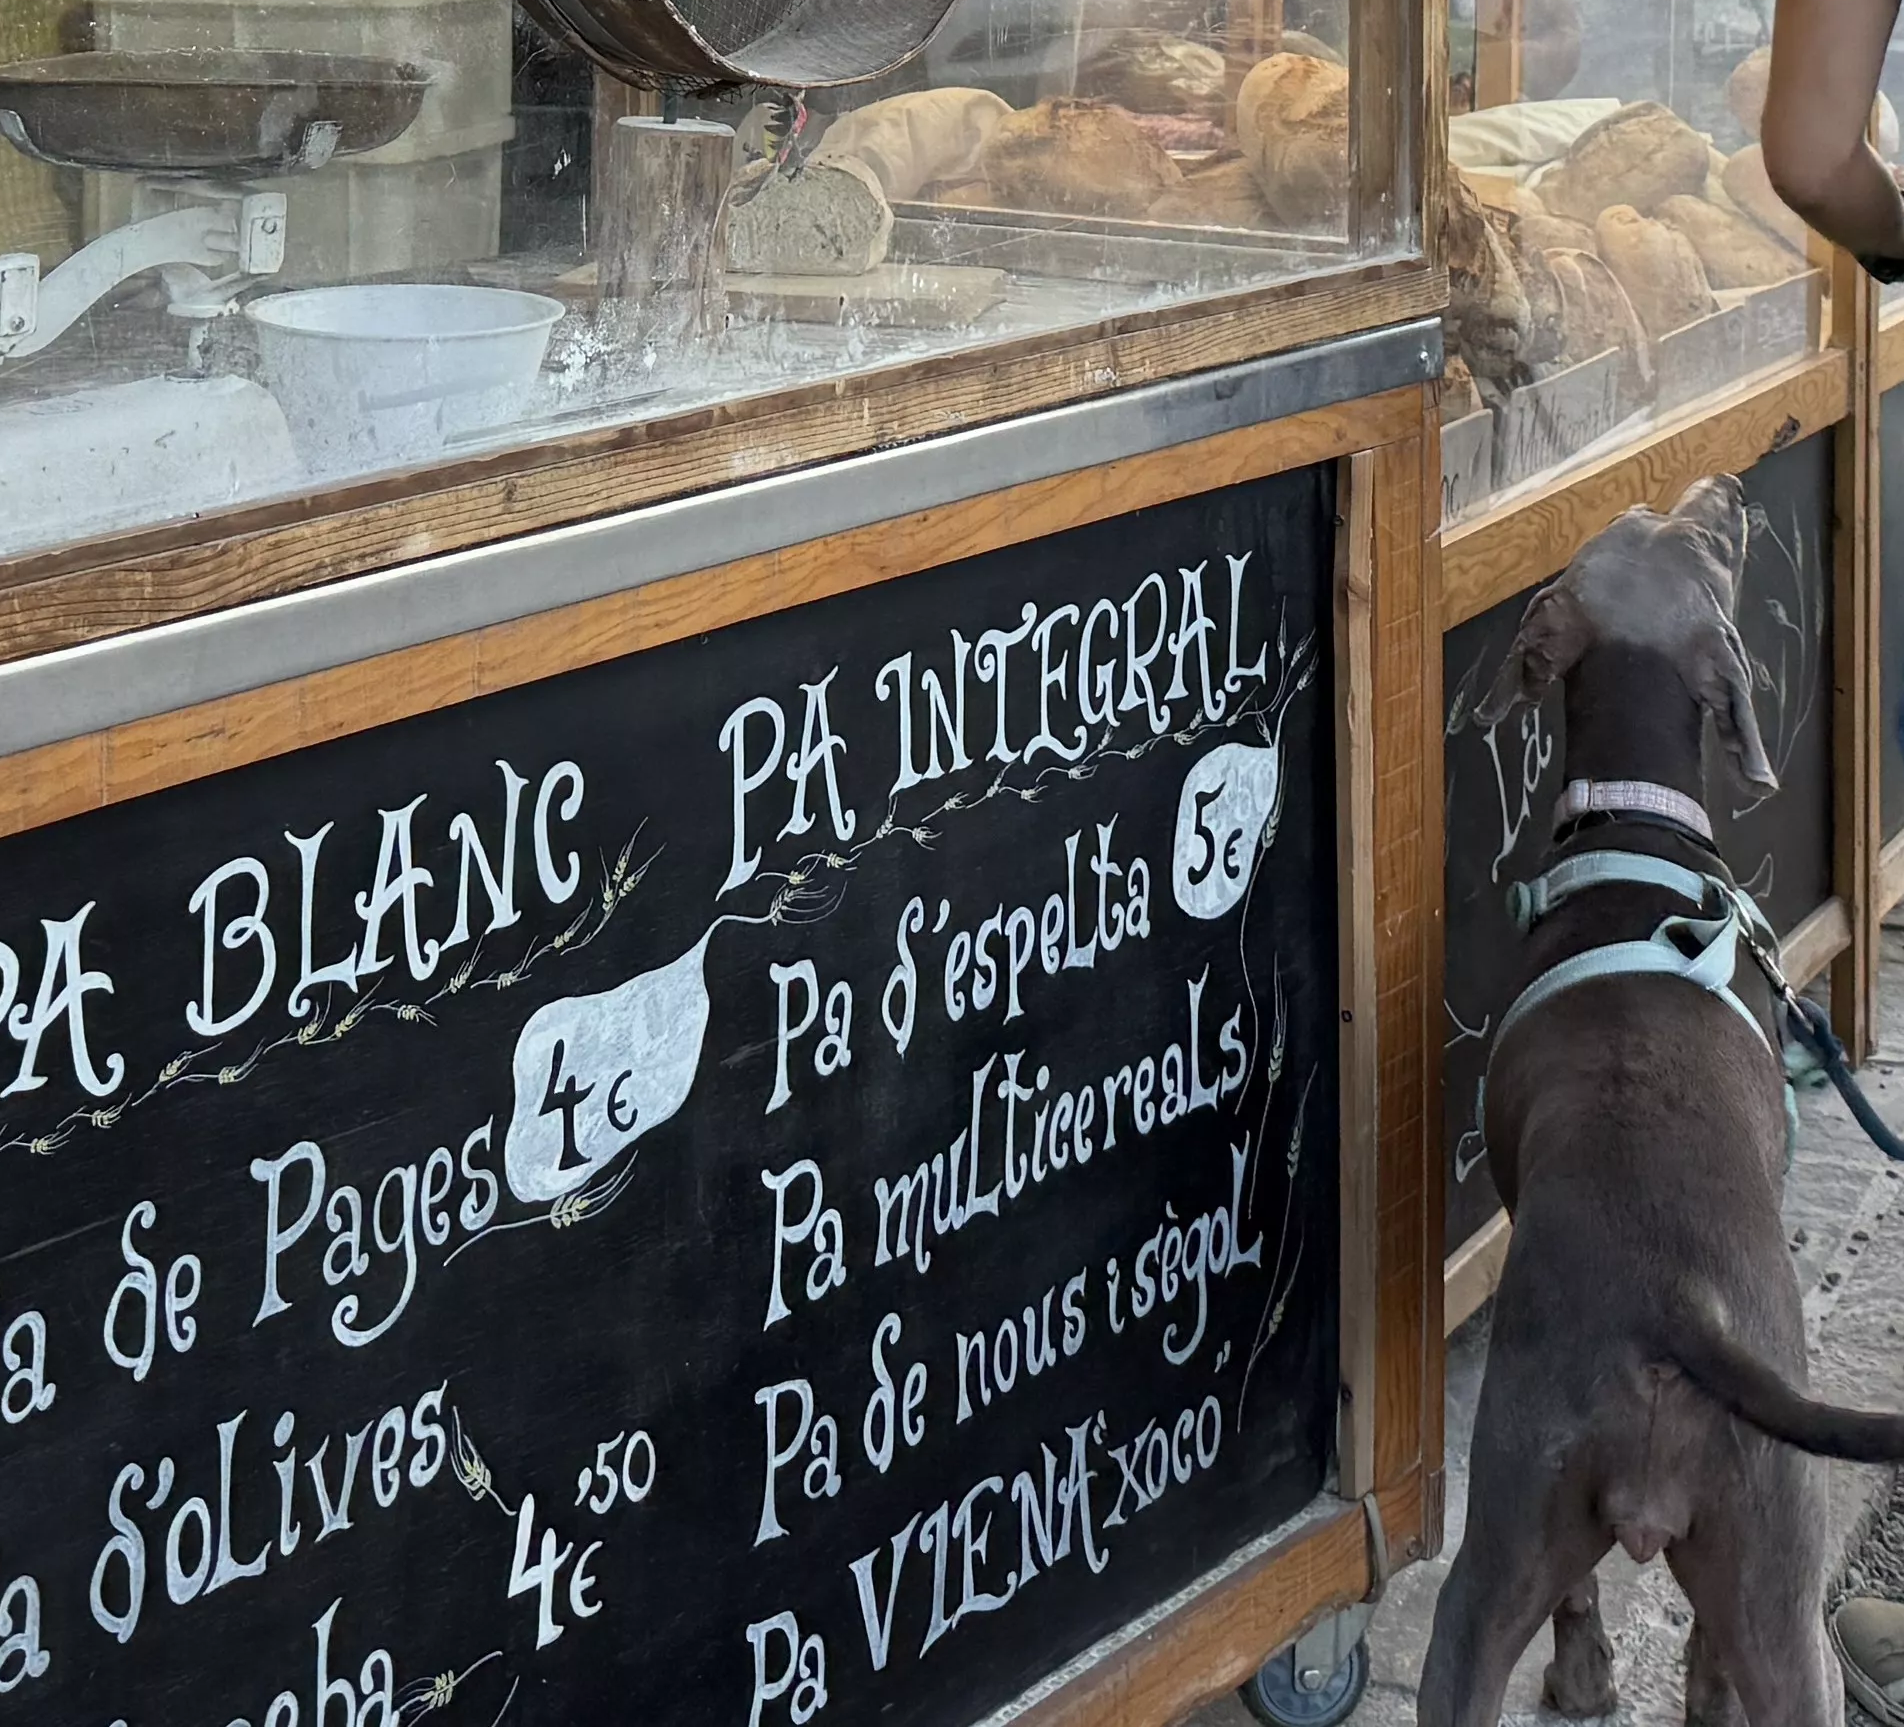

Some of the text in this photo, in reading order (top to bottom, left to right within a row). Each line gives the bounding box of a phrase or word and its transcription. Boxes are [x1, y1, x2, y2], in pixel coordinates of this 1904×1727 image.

[715, 550, 1268, 902] PA INTEGRAL
[185, 758, 586, 1038] BLANC
[764, 959, 854, 1115] Pa
[1187, 776, 1242, 887] 5€
[103, 1200, 202, 1382] de
[250, 1114, 498, 1347] Pages
[537, 1038, 640, 1172] 4€
[761, 1159, 846, 1332] Pa
[753, 1378, 843, 1548] Pa
[863, 1312, 928, 1474] de
[956, 1267, 1088, 1425] nous
[1107, 1257, 1126, 1335] i
[746, 1609, 828, 1727] Pa
[848, 1417, 1110, 1672] VIENA
